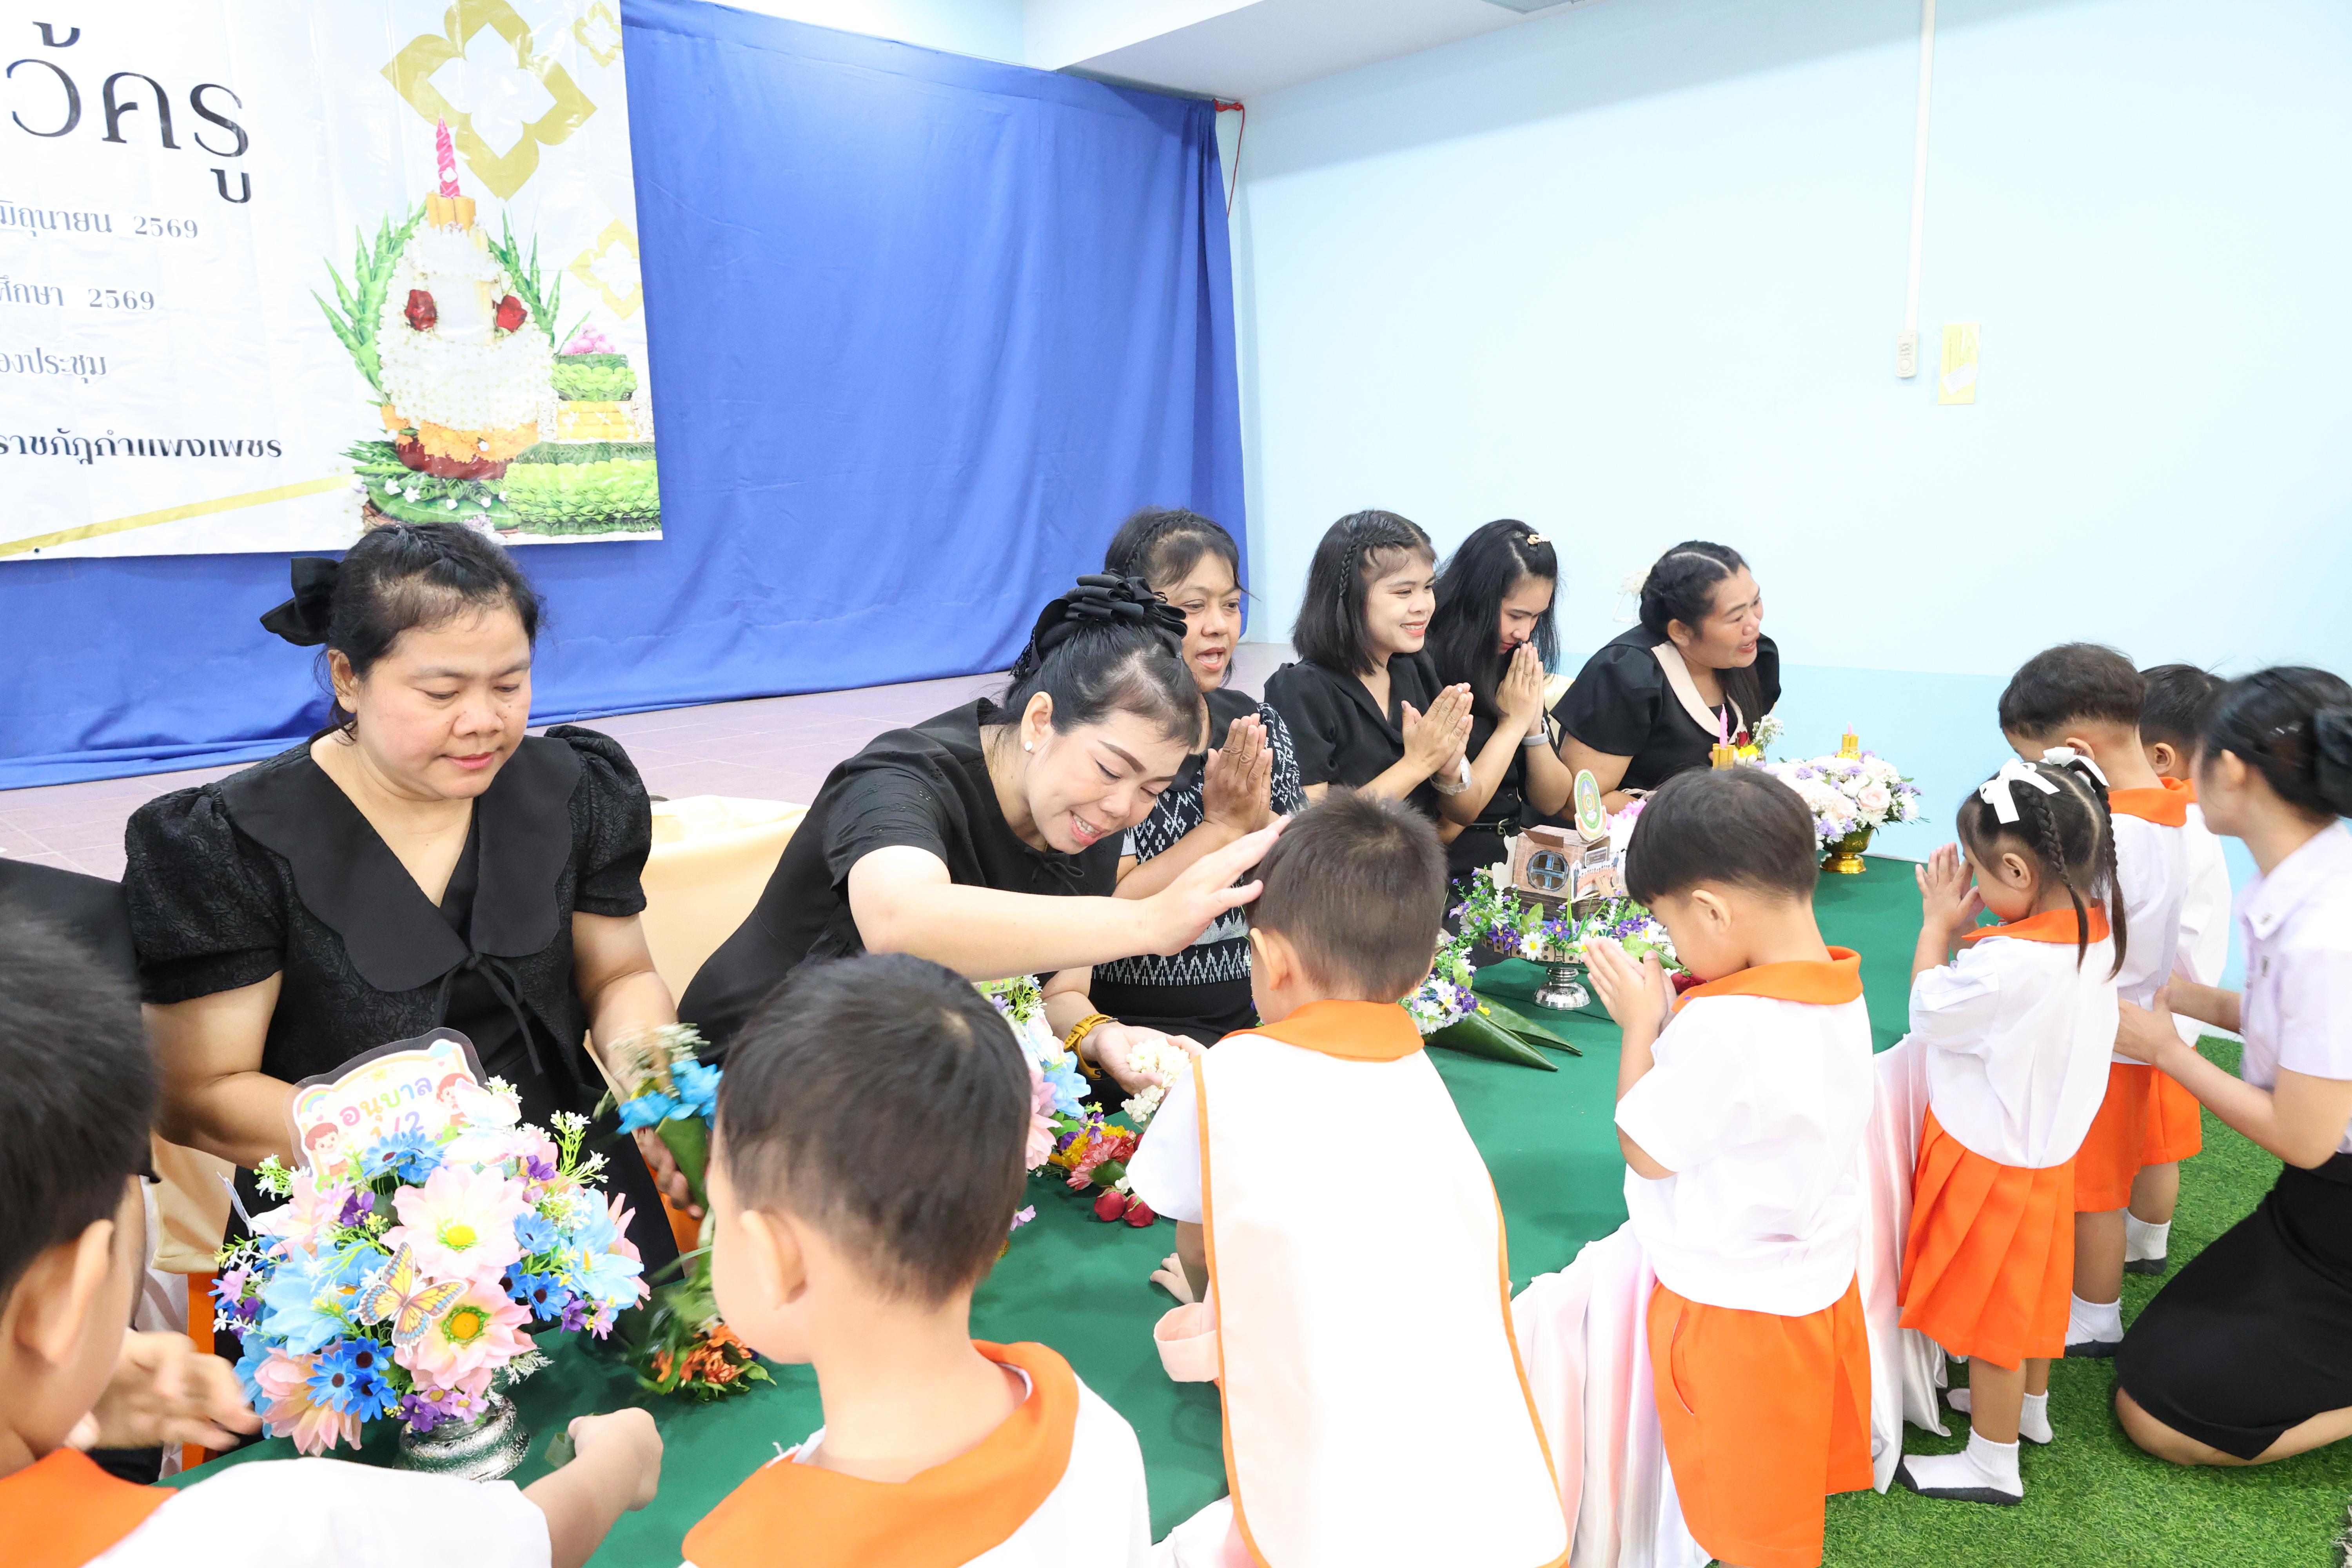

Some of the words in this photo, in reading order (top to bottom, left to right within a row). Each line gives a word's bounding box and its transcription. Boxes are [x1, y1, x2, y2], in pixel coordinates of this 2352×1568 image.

[134, 216, 198, 238] 2569
[88, 289, 154, 310] 2569
[340, 1077, 432, 1126] อนุบาล
